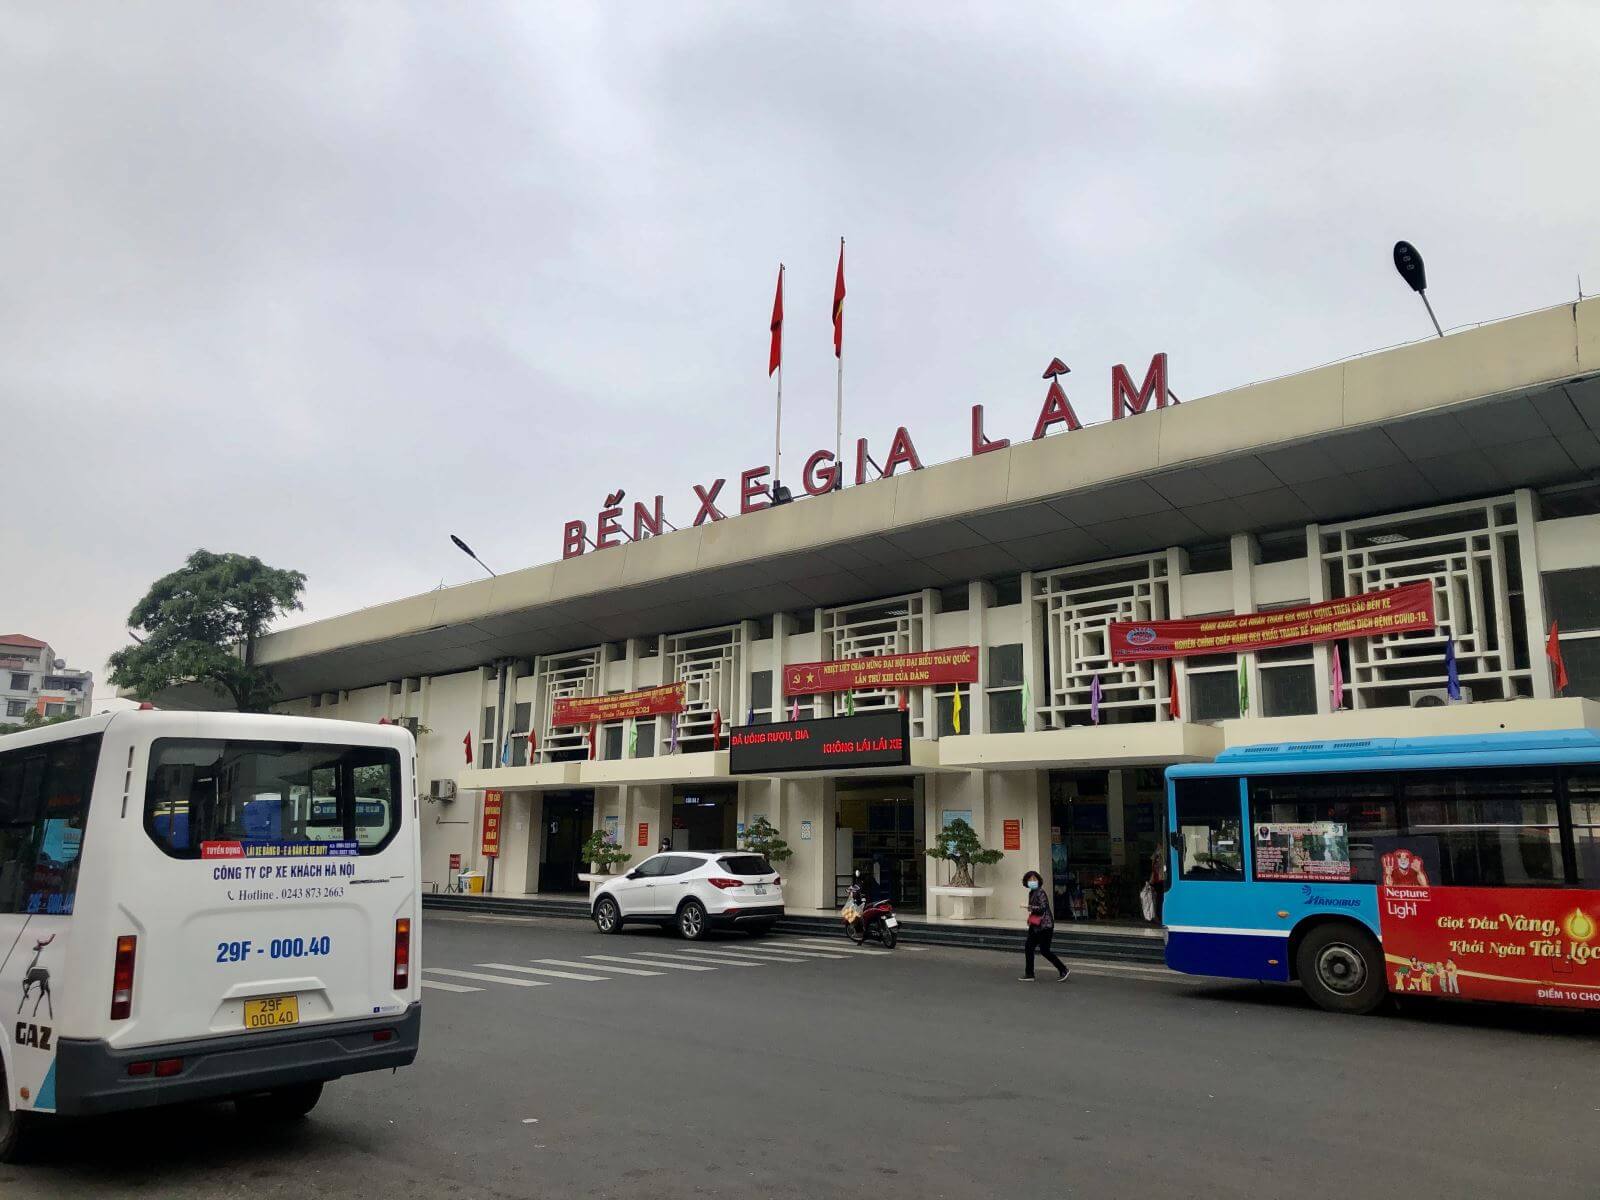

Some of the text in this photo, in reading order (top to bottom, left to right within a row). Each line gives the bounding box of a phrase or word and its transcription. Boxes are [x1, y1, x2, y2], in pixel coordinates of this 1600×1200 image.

[563, 352, 1169, 559] BẾN XE GIA LÂM
[1314, 606, 1333, 620] ĐỘNG
[1334, 602, 1352, 615] TRÊN
[1352, 600, 1366, 612] CÁC
[1366, 597, 1381, 611] BẾN
[1382, 598, 1391, 609] XE
[1262, 627, 1278, 641] KHẨU
[1279, 626, 1299, 639] TRANG
[1310, 620, 1332, 635] PHÒNG
[1334, 618, 1356, 632] CHỐNG
[1357, 617, 1373, 632] DỊCH
[1374, 614, 1393, 630] BỆNH
[824, 651, 970, 676] NHIỆT LIỆT CHÀO MỪNG ĐẠI HỘI ĐẠI BIỂU TOÀN QUỐC
[855, 669, 930, 684] LẦN THỨ XIII CỦA ĐẢNG
[767, 731, 793, 744] RƯỢU,
[795, 729, 809, 740] BIA
[823, 736, 903, 754] KHÔNG LÁI LÁI XE
[207, 844, 241, 856] TUYỂN DỤNG
[213, 862, 355, 880] CÔNG TY CP XE KHÁCH HÀ NỘI
[238, 888, 274, 901] Hotline
[281, 887, 303, 899] 0243
[305, 887, 321, 898] 873
[323, 886, 344, 898] 2663
[1304, 895, 1361, 907] HANOIBUS
[1385, 887, 1429, 899] Neptune
[1387, 901, 1418, 919] Light
[1437, 913, 1561, 937] Giọt Dầu Vàng,
[216, 940, 252, 963] 29F
[270, 935, 331, 959] 000.40
[1449, 940, 1600, 965] Khởi Ngàn Tài Lộc
[1537, 988, 1600, 1002] ĐIỂM 10 CHO
[251, 999, 294, 1027] 29F 000.40
[15, 1021, 52, 1051] GAZ
